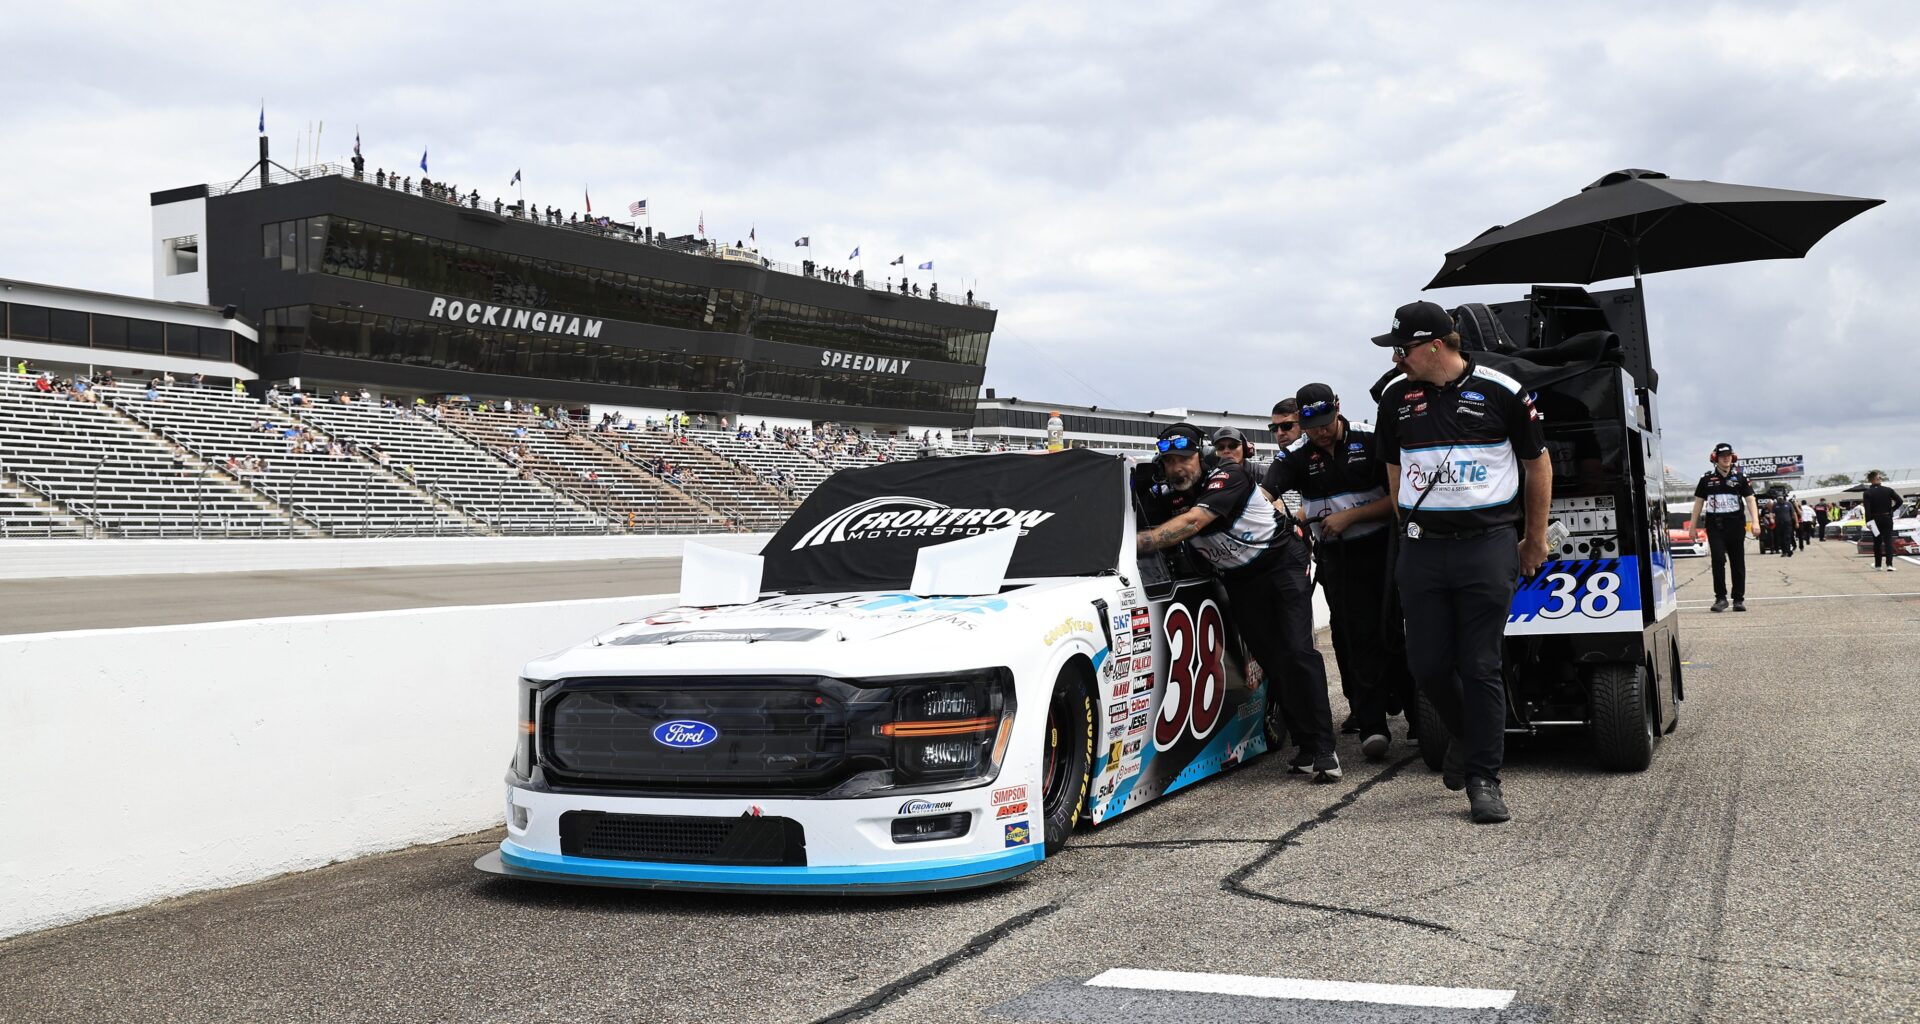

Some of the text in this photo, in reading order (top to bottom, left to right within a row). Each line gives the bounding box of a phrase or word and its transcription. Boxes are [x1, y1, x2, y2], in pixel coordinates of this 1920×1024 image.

[428, 296, 603, 338] ROCKINGHAM
[820, 350, 911, 375] SPEEDWAY
[1774, 456, 1799, 465] BACK
[1743, 465, 1777, 475] NASCAR
[1538, 571, 1621, 620] 38
[1113, 613, 1131, 631] SKF
[1132, 655, 1152, 671] CALICO
[1153, 598, 1227, 753] 38
[1129, 713, 1147, 731] JESEL
[664, 723, 705, 743] Ford
[993, 788, 1027, 804] SIMPSON
[911, 801, 953, 811] FRONTROW
[996, 801, 1029, 817] ARP
[1005, 829, 1029, 841] SUNOCO
